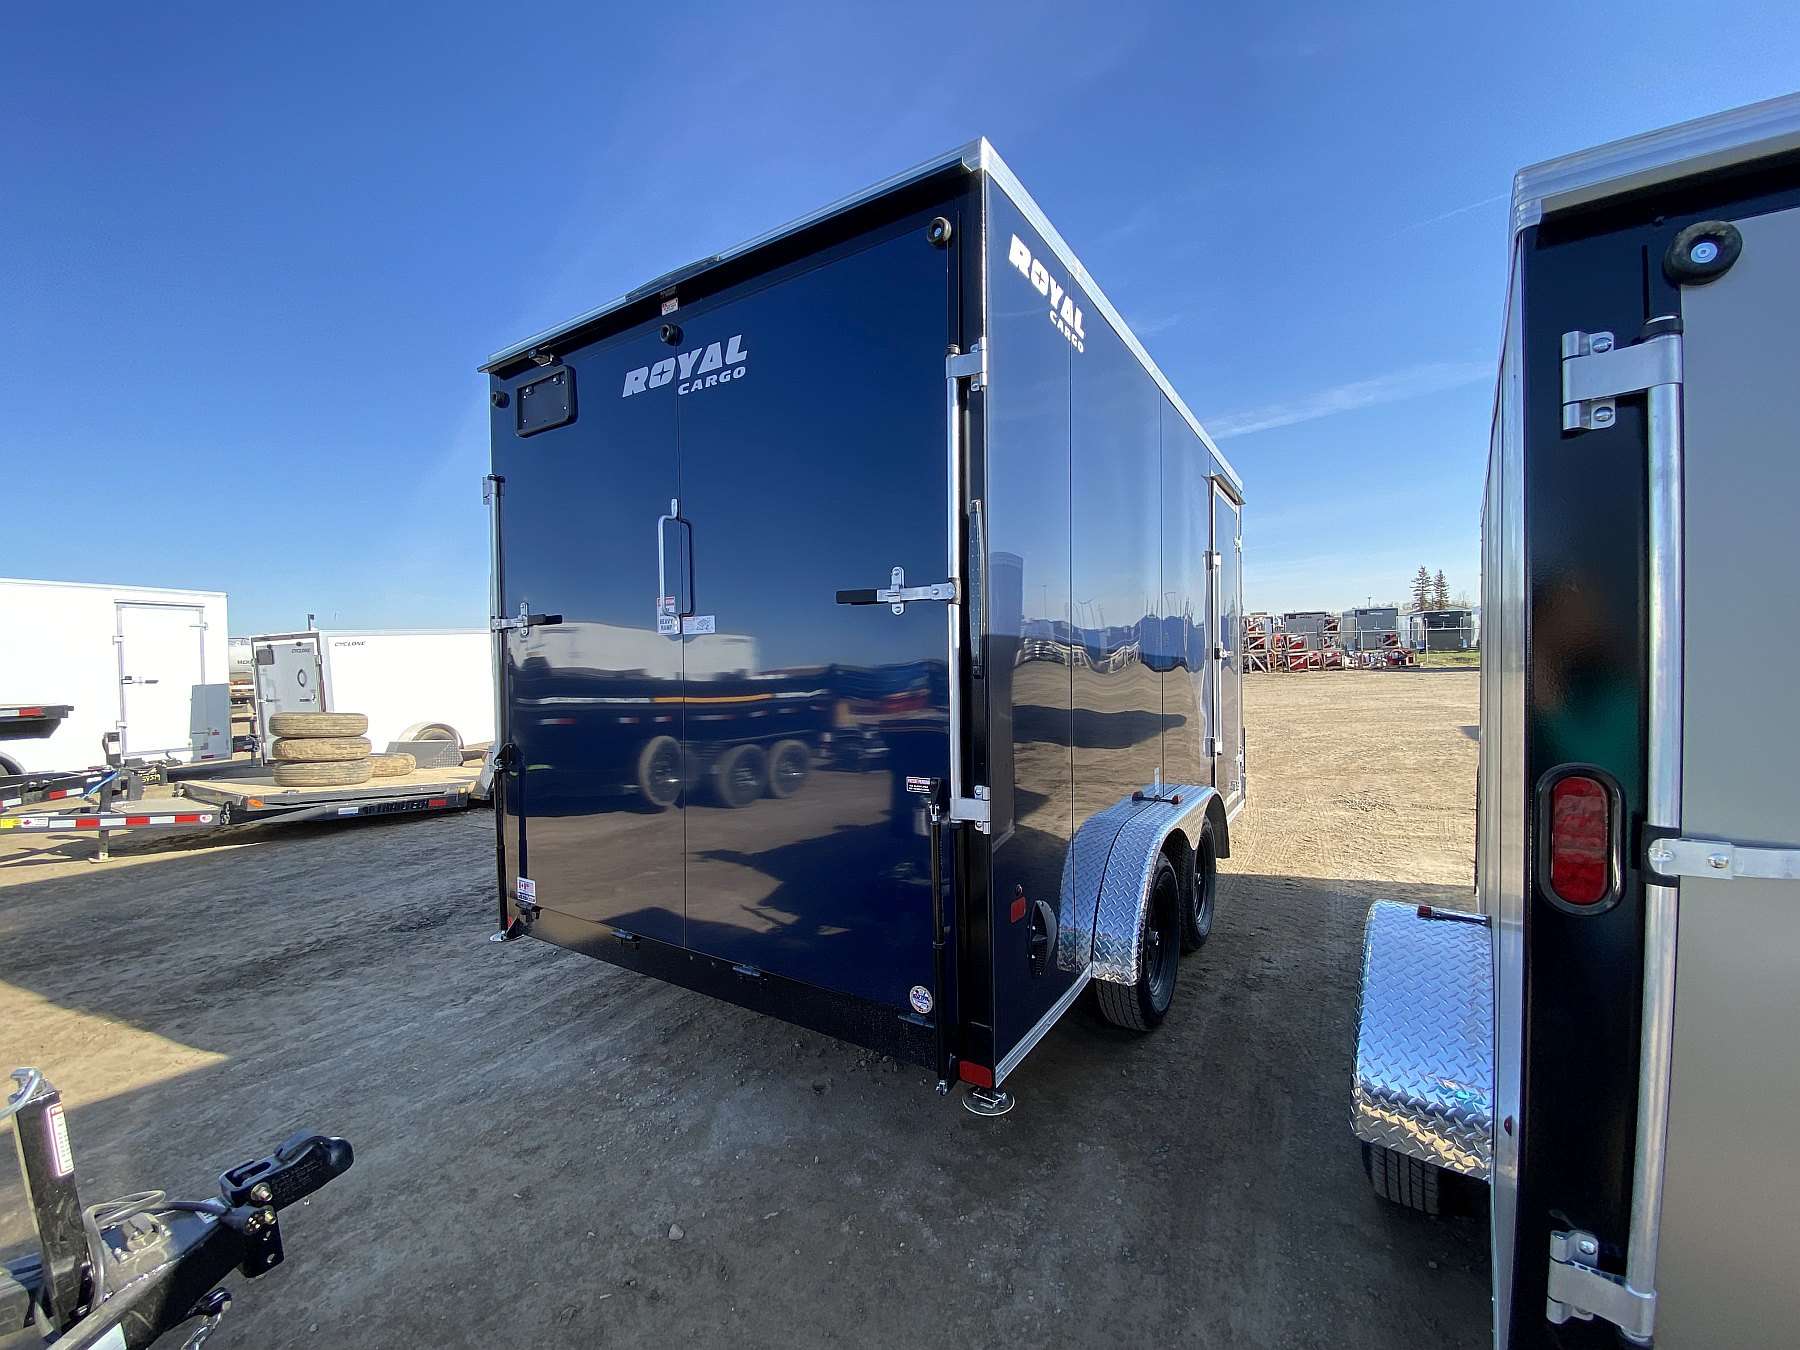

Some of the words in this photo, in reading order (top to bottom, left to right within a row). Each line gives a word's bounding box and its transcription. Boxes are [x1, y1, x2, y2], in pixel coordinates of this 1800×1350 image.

[1009, 233, 1085, 338] ROYAL
[1049, 311, 1084, 353] CARGO
[622, 334, 748, 398] ROYAL
[678, 366, 746, 395] CARGO
